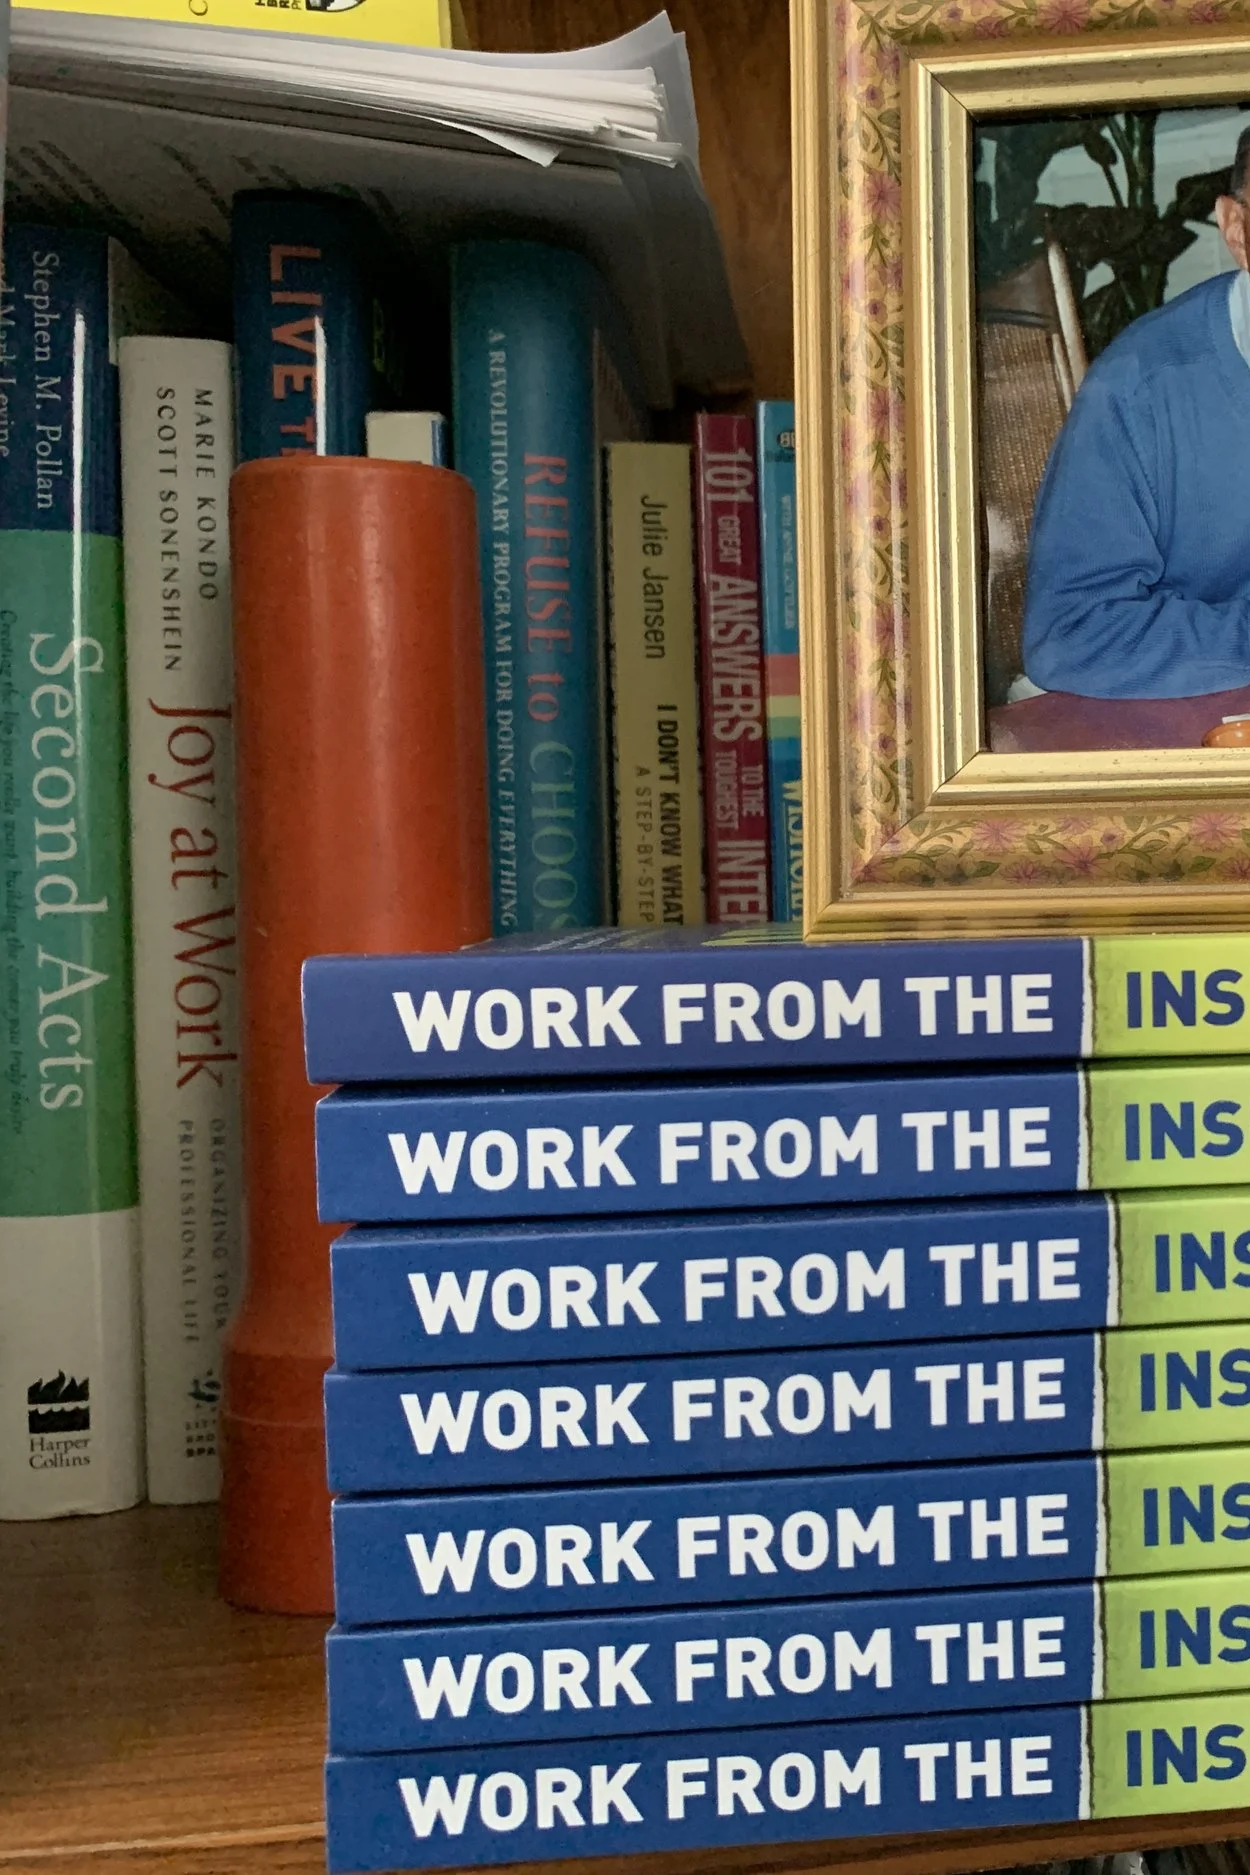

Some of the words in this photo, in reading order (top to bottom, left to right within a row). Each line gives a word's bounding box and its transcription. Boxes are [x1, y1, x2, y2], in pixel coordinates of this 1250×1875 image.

[24, 250, 61, 362] Stephen
[488, 330, 506, 344] A
[35, 375, 62, 410] M.
[156, 386, 178, 477] SCOTT
[195, 388, 216, 479] MARIE
[36, 424, 63, 510] Pollan
[488, 350, 509, 536] REVOLUTIONARY
[705, 448, 754, 503] 101
[197, 496, 220, 601] KONDO
[523, 452, 572, 653] REFUSE
[641, 495, 669, 557] Julie
[718, 515, 742, 566] GREAT
[159, 489, 182, 672] SONENSHEIN
[493, 542, 513, 652] PROGRAM
[643, 567, 670, 660] Jansen
[495, 660, 513, 701] FOR
[527, 672, 565, 722] to
[710, 573, 763, 743] ANSWERS
[147, 698, 234, 808] Joy
[496, 709, 516, 783] DOING
[657, 704, 678, 712] I
[657, 720, 681, 785] DON'T
[29, 633, 109, 921] Second
[636, 766, 651, 778] A
[715, 750, 740, 831] TOUGHEST
[170, 827, 229, 890] at
[498, 789, 519, 927] EVERYTHING
[636, 787, 656, 924] STEP-BY-STEP
[660, 792, 683, 857] KNOW
[662, 865, 685, 926] WHAT
[718, 840, 769, 923] INTE
[37, 943, 110, 1111] Acts
[173, 906, 239, 1089] Work
[392, 985, 641, 1052] WORK
[663, 979, 881, 1044] FROM
[904, 974, 1053, 1035] THE
[210, 1117, 229, 1260] ORGANIZING
[388, 1124, 636, 1195] WORK
[659, 1114, 878, 1184] FROM
[901, 1107, 1051, 1172] THE
[178, 1118, 198, 1286] PROFESSIONAL
[183, 1299, 200, 1343] LIFE
[408, 1262, 661, 1335] WORK
[684, 1248, 905, 1322] FROM
[929, 1238, 1081, 1306] THE
[29, 1437, 91, 1454] Harper
[400, 1383, 649, 1455] WORK
[673, 1369, 891, 1441] FROM
[915, 1358, 1065, 1426] THE
[29, 1453, 91, 1469] Collins
[405, 1520, 654, 1594] WORK
[677, 1505, 895, 1578] FROM
[918, 1494, 1068, 1562] THE
[403, 1643, 652, 1720] WORK
[675, 1628, 892, 1702] FROM
[915, 1616, 1065, 1684] THE
[398, 1763, 644, 1838] WORK
[667, 1747, 881, 1820] FROM
[904, 1736, 1052, 1801] THE
